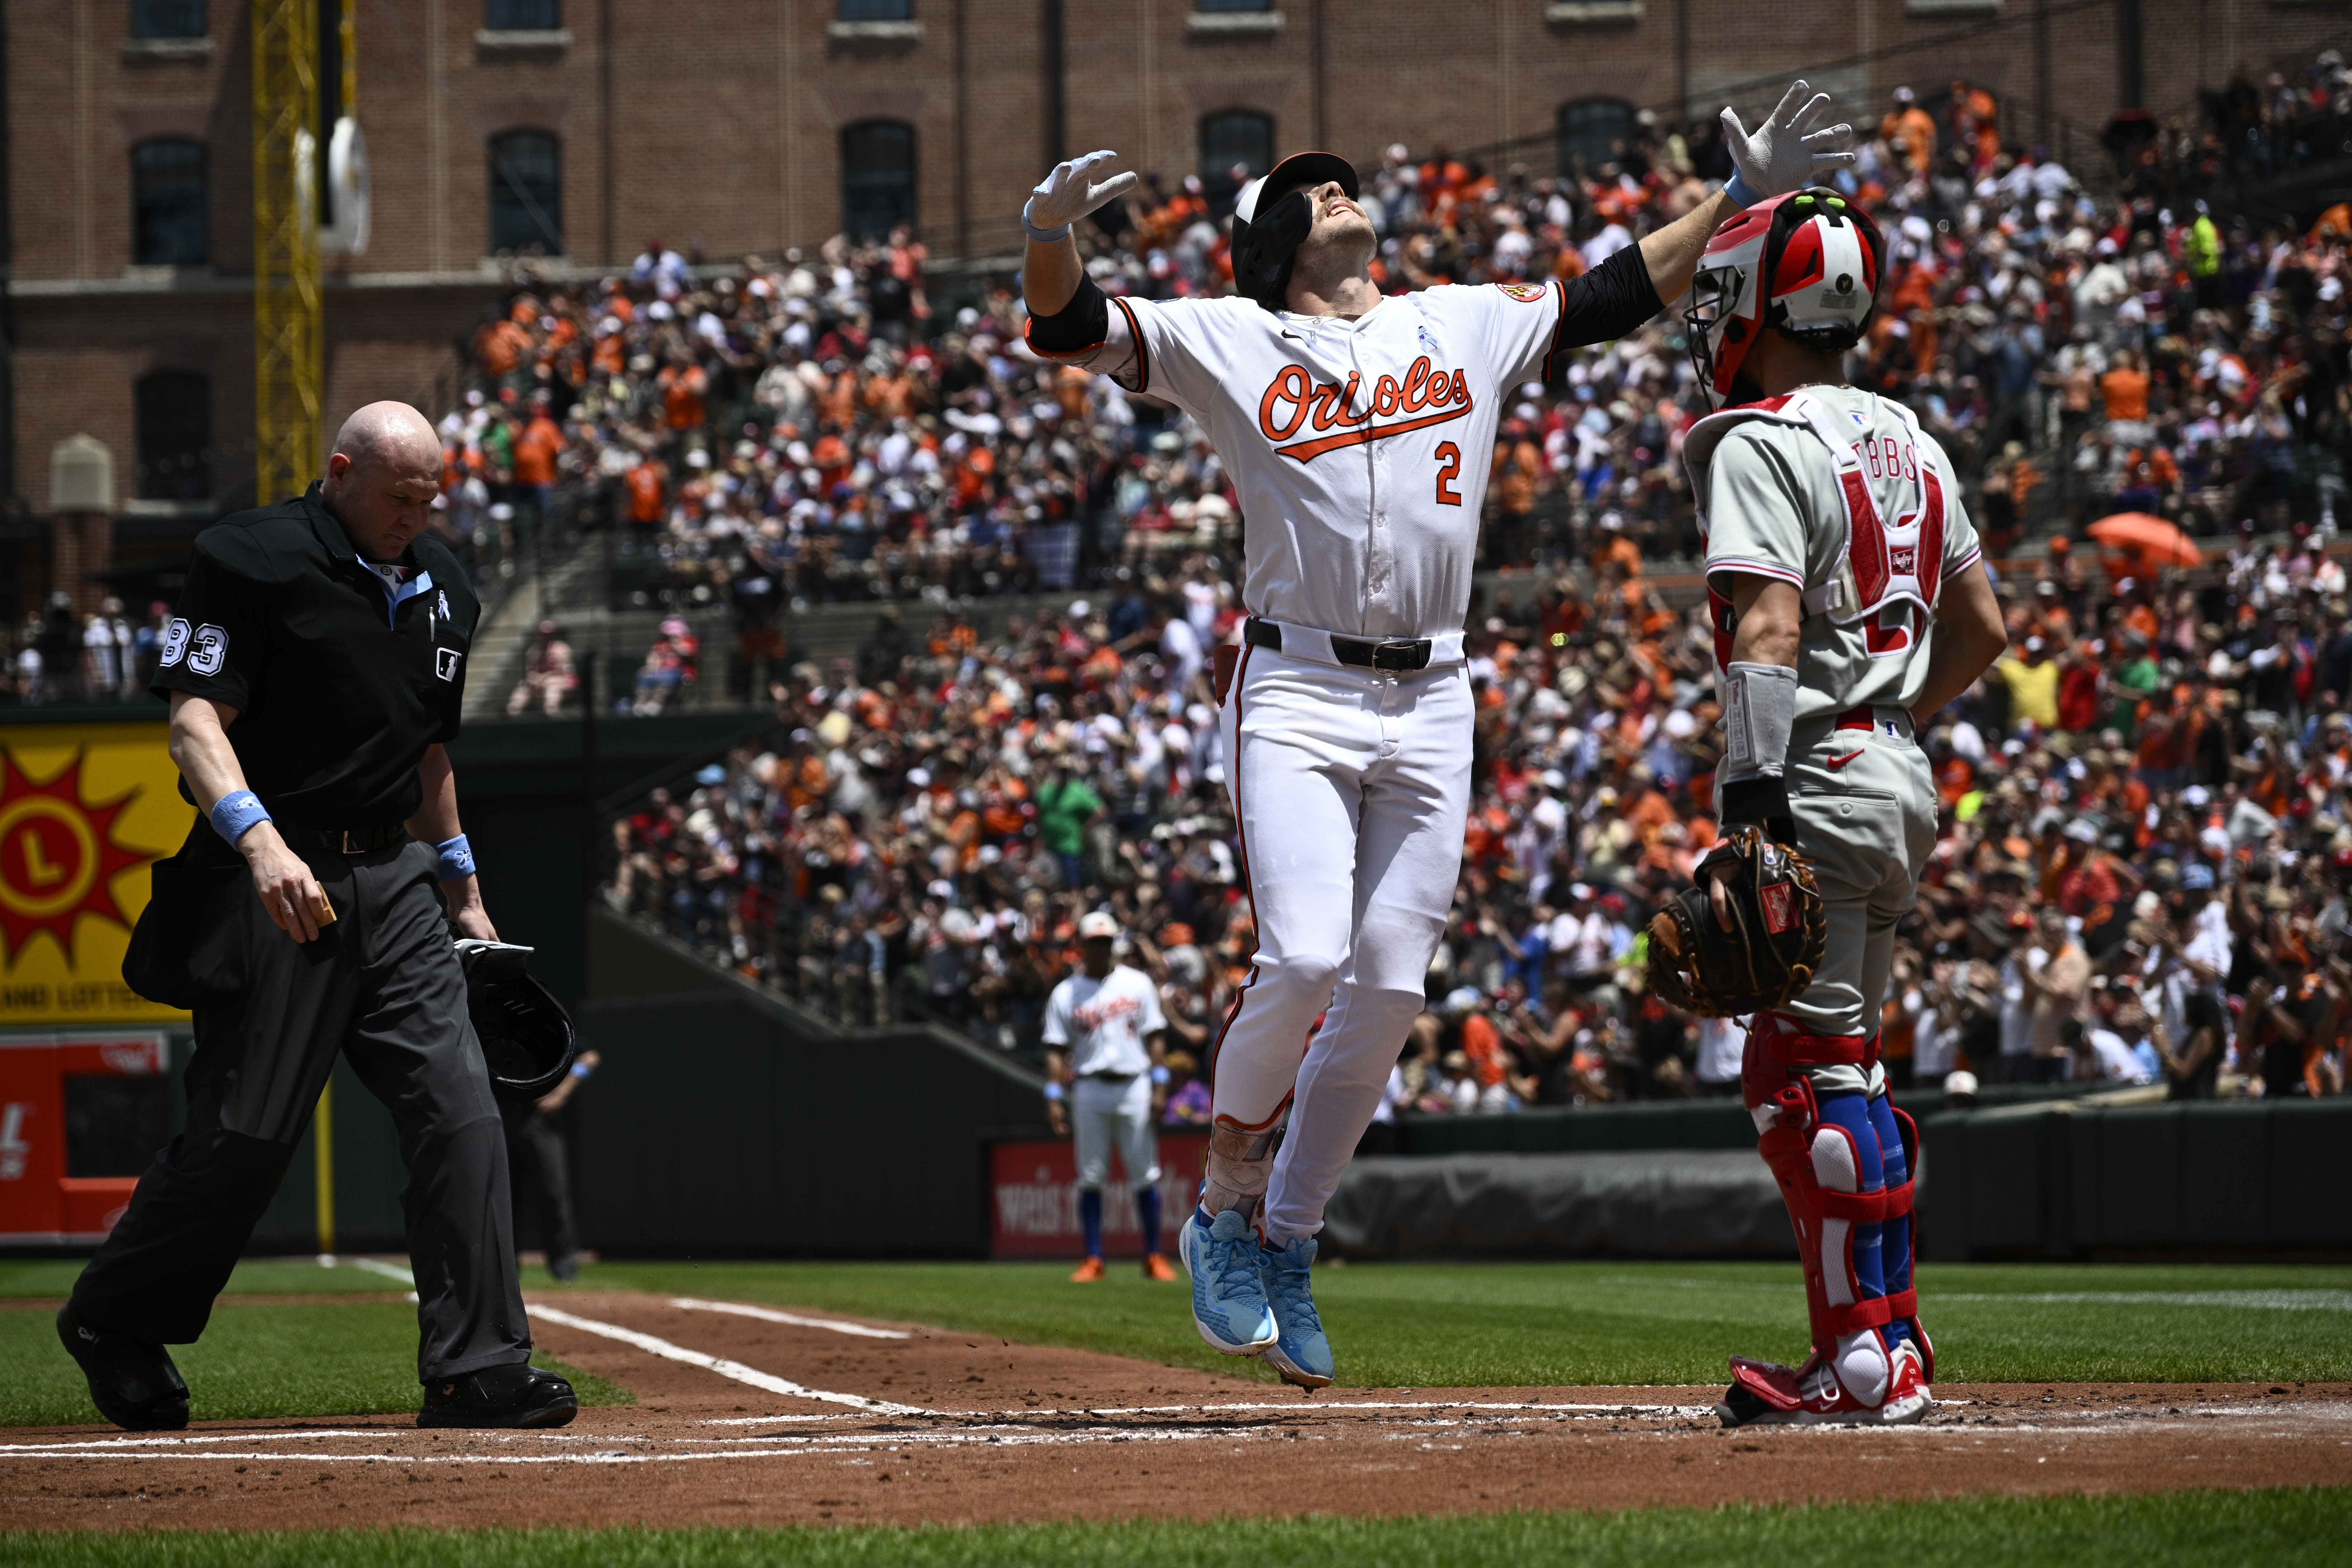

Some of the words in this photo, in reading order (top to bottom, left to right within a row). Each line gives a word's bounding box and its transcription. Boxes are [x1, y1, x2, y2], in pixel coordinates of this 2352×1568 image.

[1258, 355, 1473, 464] Orioles
[1434, 441, 1461, 506] 2
[160, 617, 229, 676] 83
[20, 827, 67, 888] L
